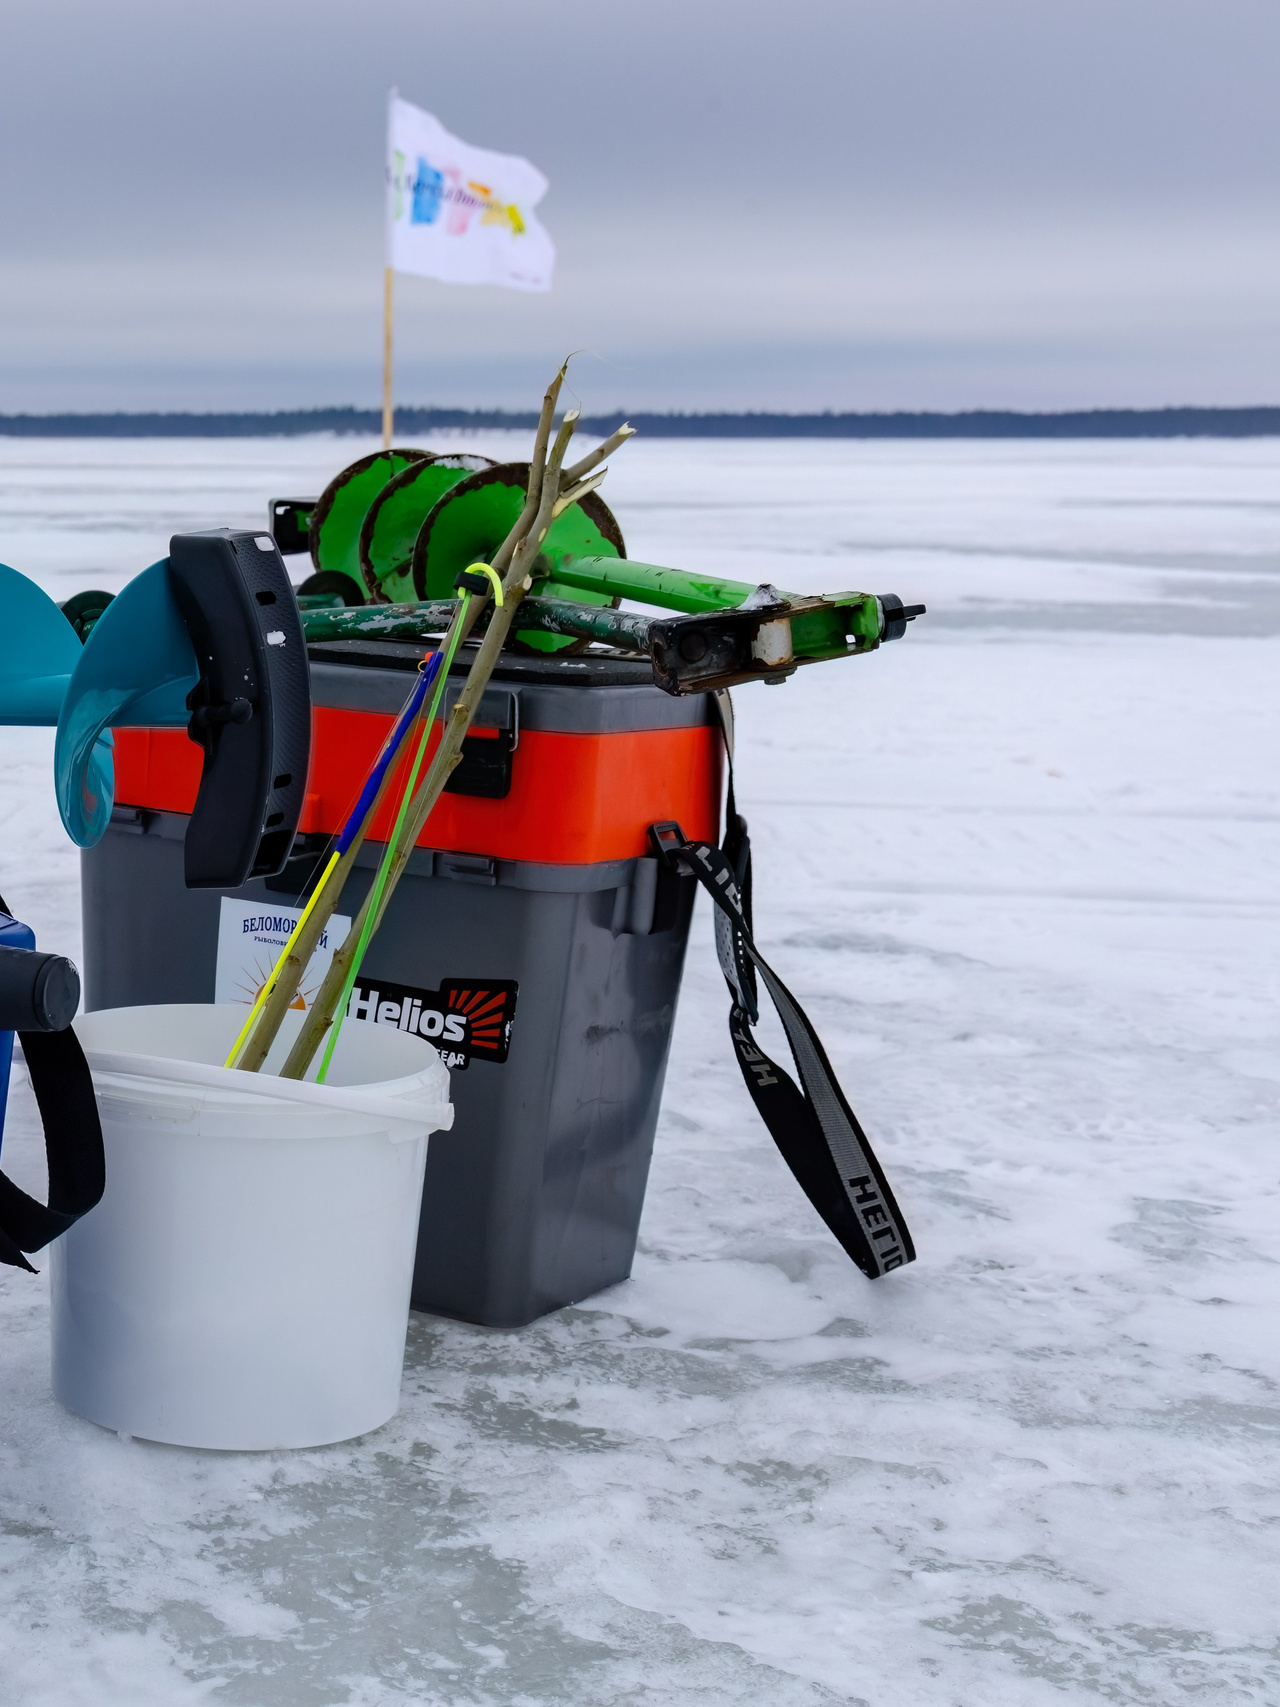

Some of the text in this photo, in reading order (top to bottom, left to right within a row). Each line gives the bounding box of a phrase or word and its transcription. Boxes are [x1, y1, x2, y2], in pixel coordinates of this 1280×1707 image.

[242, 916, 328, 949] БЕЛОМОРЙ
[253, 936, 289, 947] РЫБОЛОВ
[346, 986, 467, 1042] Helios
[437, 1048, 466, 1066] EAR
